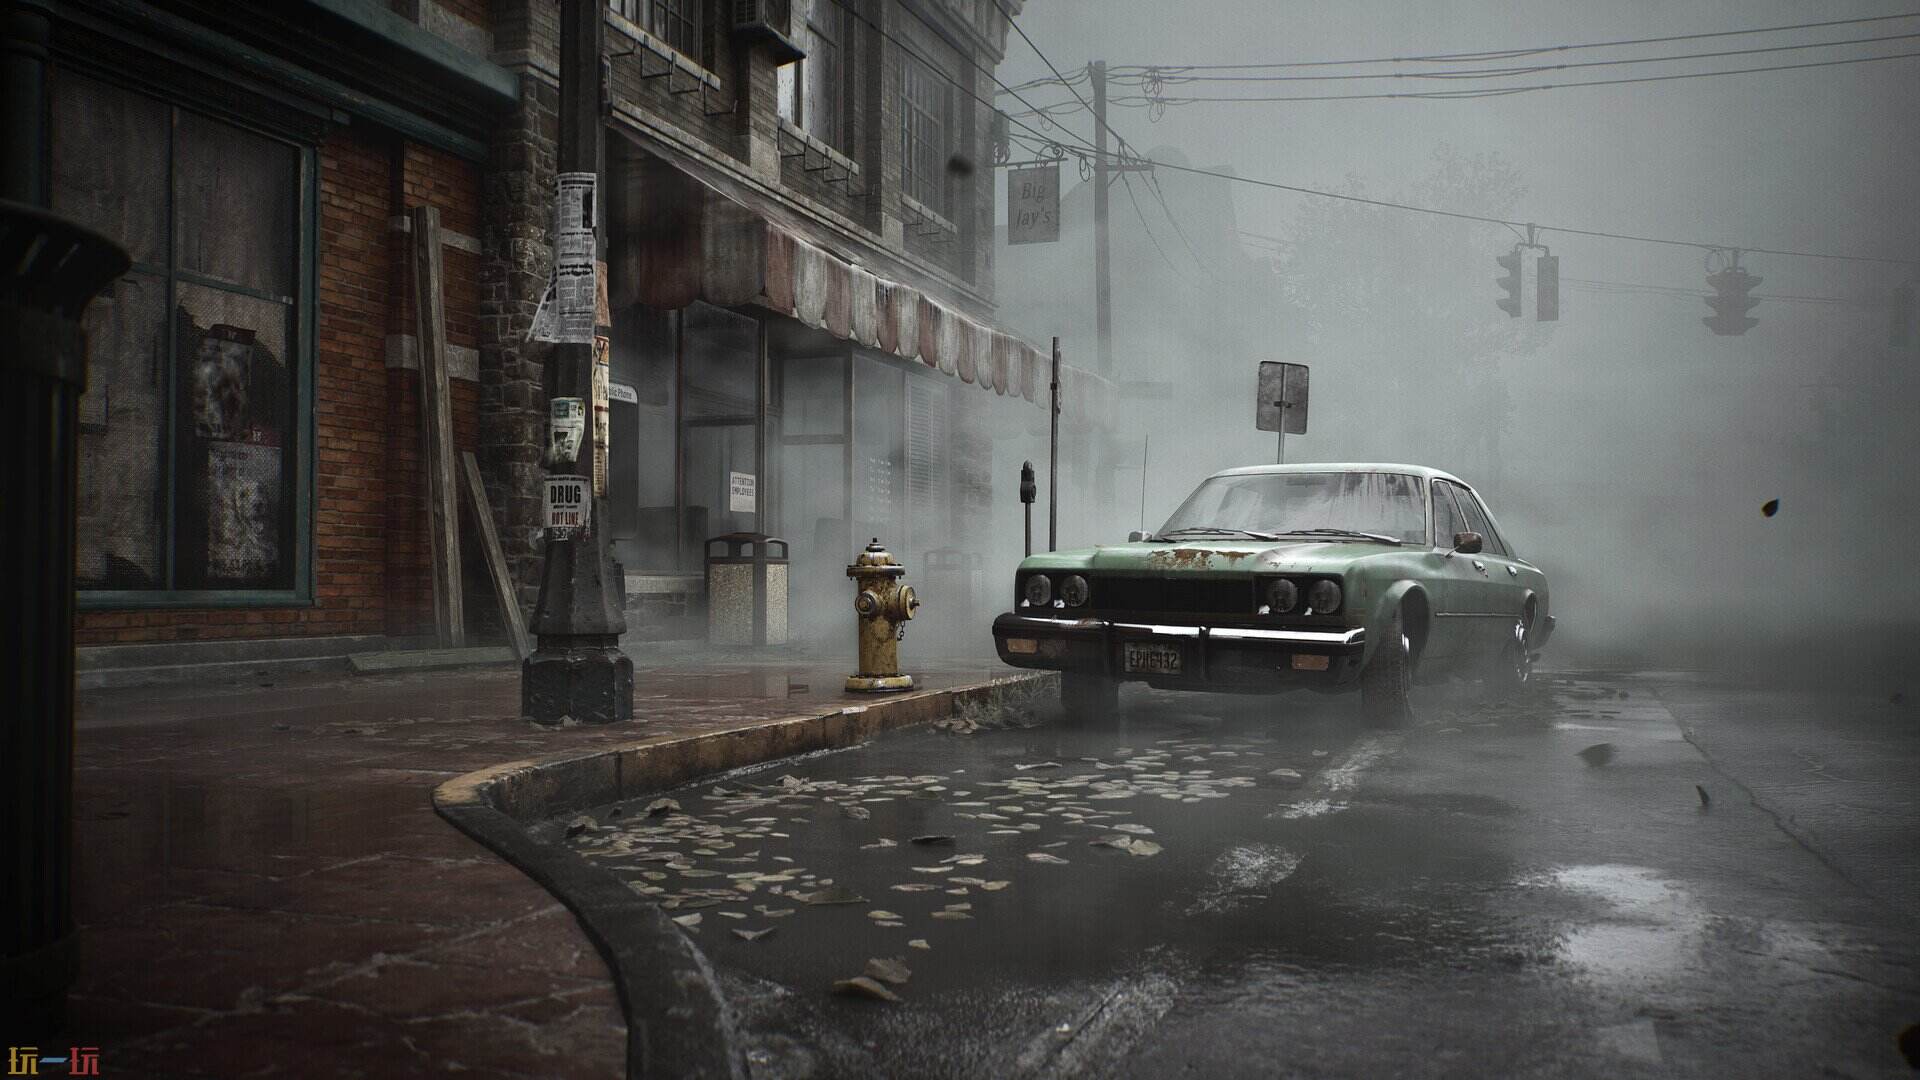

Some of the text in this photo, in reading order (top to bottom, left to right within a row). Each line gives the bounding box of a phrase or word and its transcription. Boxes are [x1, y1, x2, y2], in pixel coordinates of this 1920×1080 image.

[1021, 182, 1045, 204] Big
[732, 475, 755, 486] ATTENTION
[550, 485, 581, 504] DRUG
[565, 511, 579, 525] LINE
